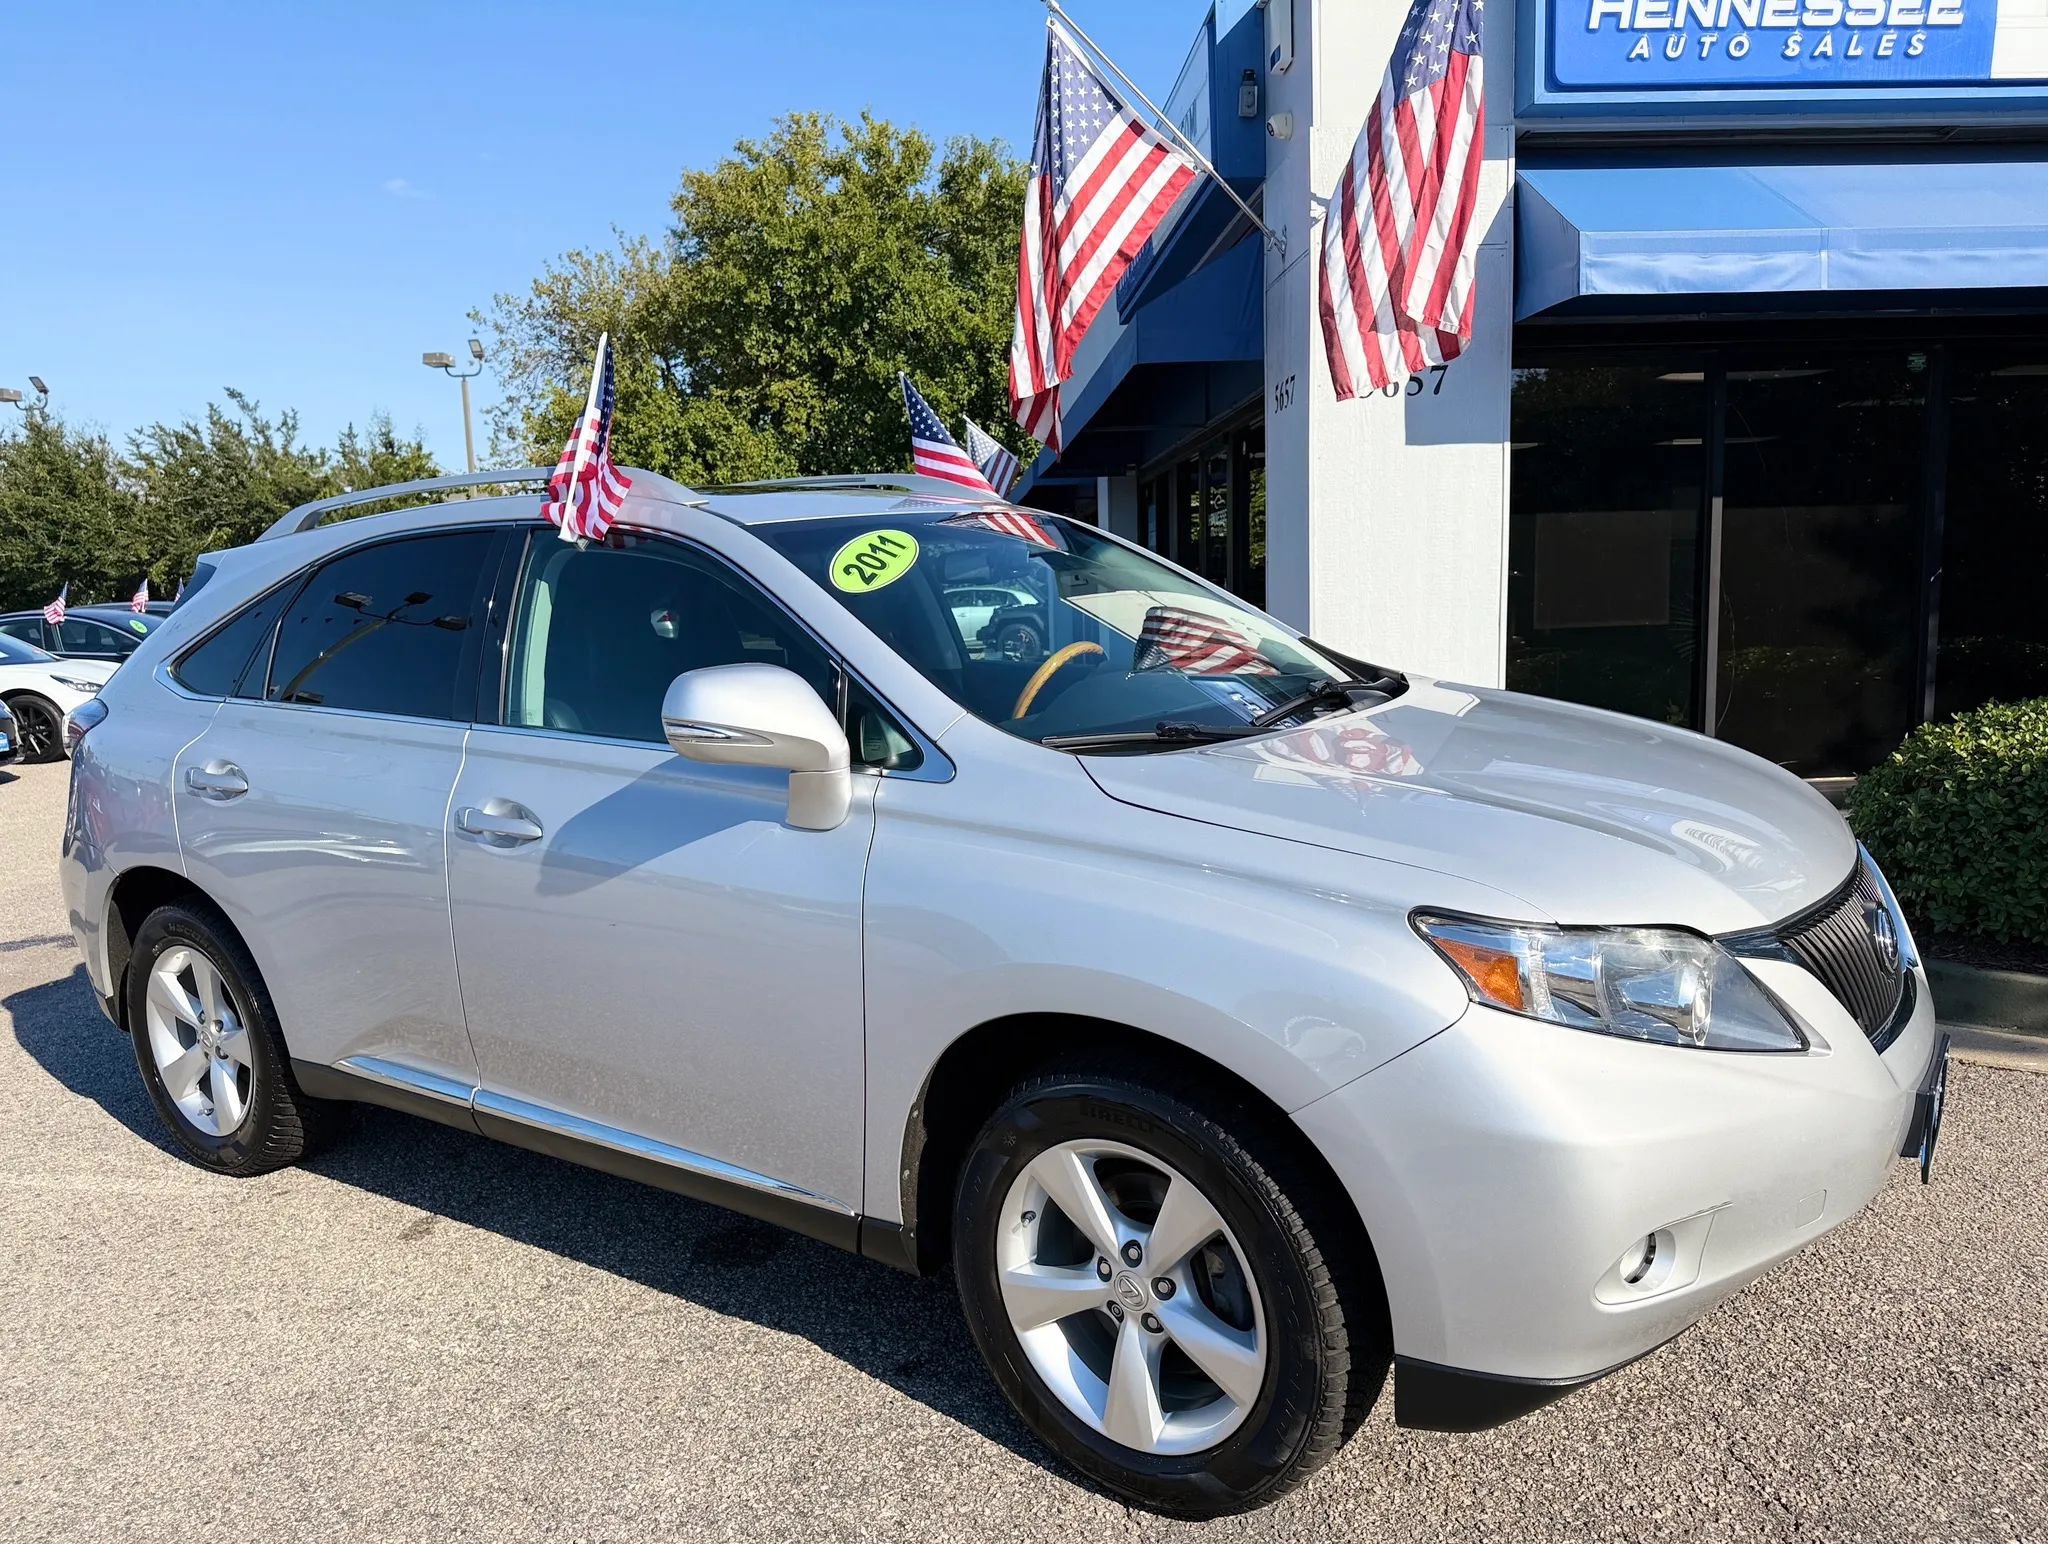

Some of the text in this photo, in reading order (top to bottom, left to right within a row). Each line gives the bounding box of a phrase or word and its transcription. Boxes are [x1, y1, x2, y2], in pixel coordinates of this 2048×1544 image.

[1587, 0, 1964, 29] HENNESSEE
[1629, 32, 1928, 59] AUTO SALES
[1274, 374, 1296, 414] 5657
[1359, 364, 1449, 398] 657
[842, 534, 907, 586] 2011
